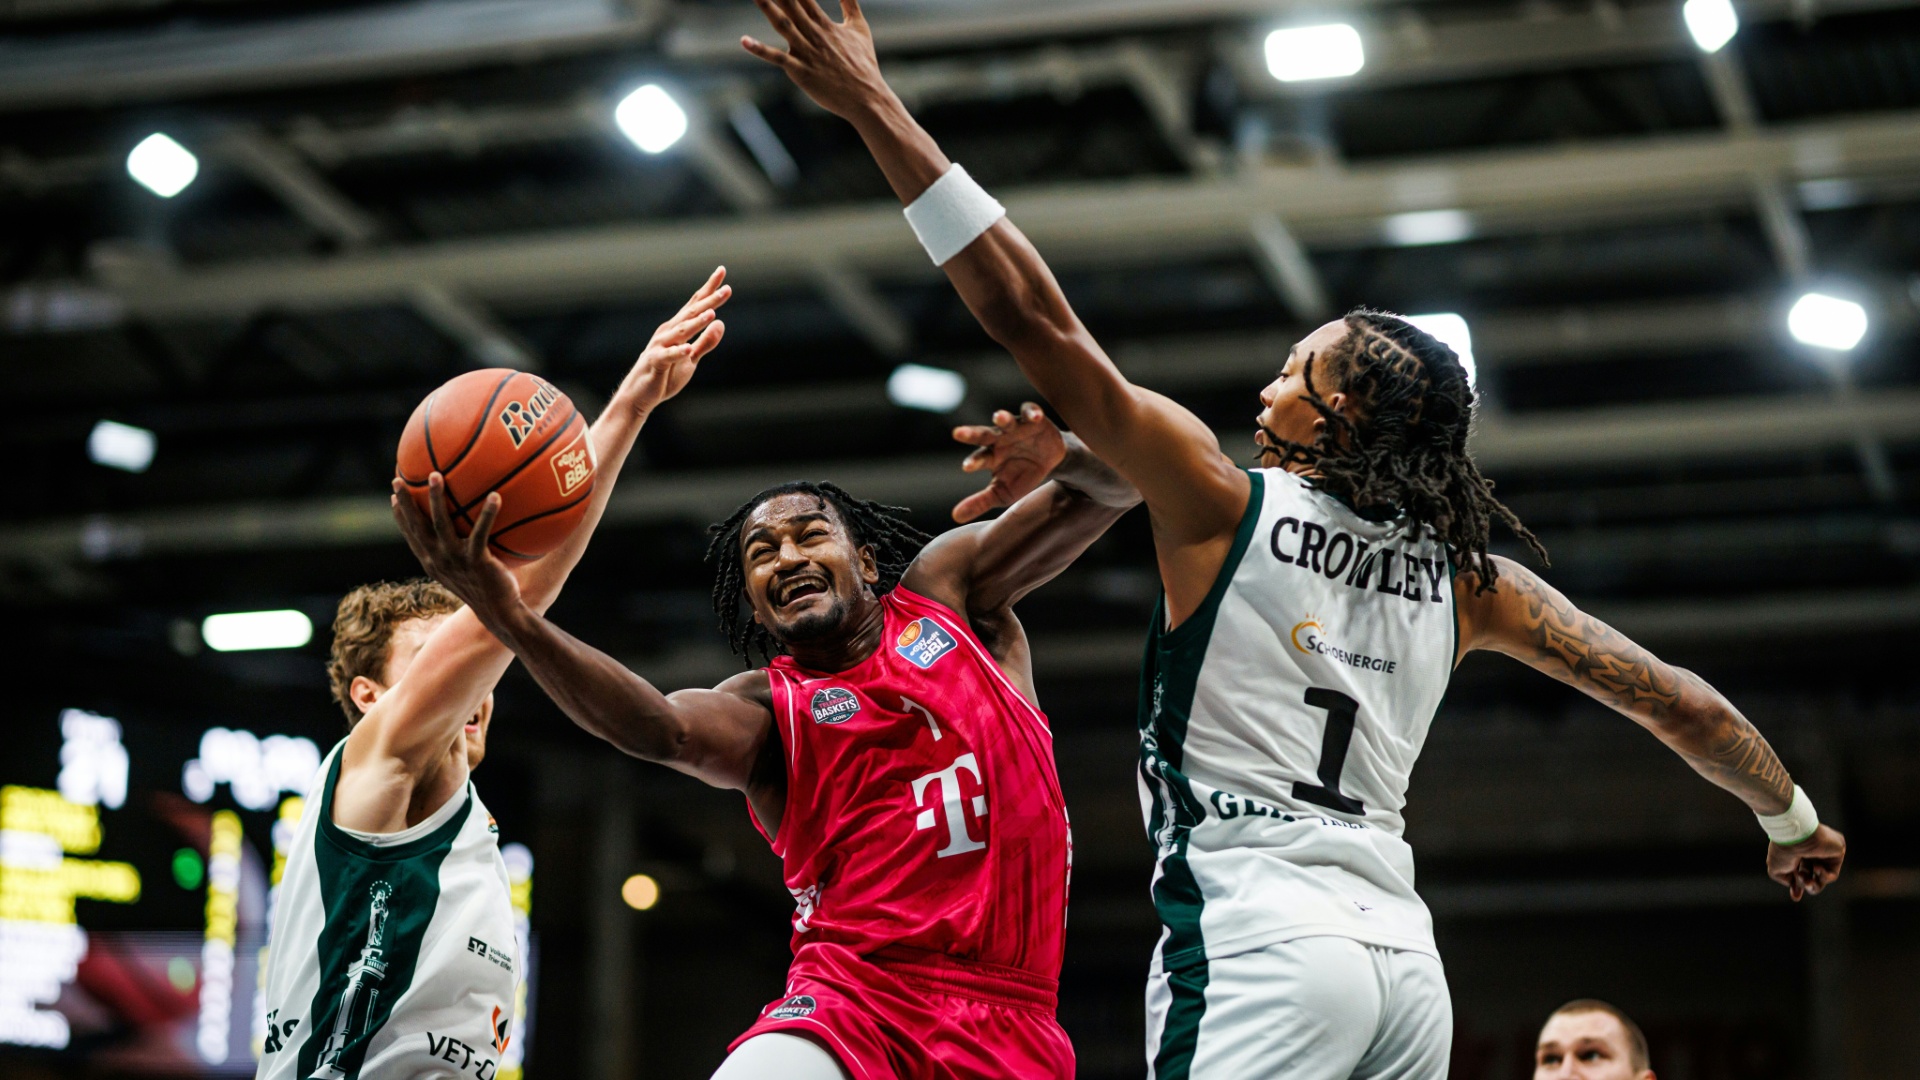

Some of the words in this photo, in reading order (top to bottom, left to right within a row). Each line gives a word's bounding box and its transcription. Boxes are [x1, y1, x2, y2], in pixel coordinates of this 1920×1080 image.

[565, 459, 589, 490] BBL
[1270, 516, 1444, 603] CROWLEY
[919, 637, 950, 665] BBL
[1306, 635, 1396, 674] SCHOENERGIE
[814, 699, 857, 720] BASKETS
[818, 696, 847, 709] TELEKOM
[832, 714, 847, 722] BONN
[1291, 686, 1366, 816] 1
